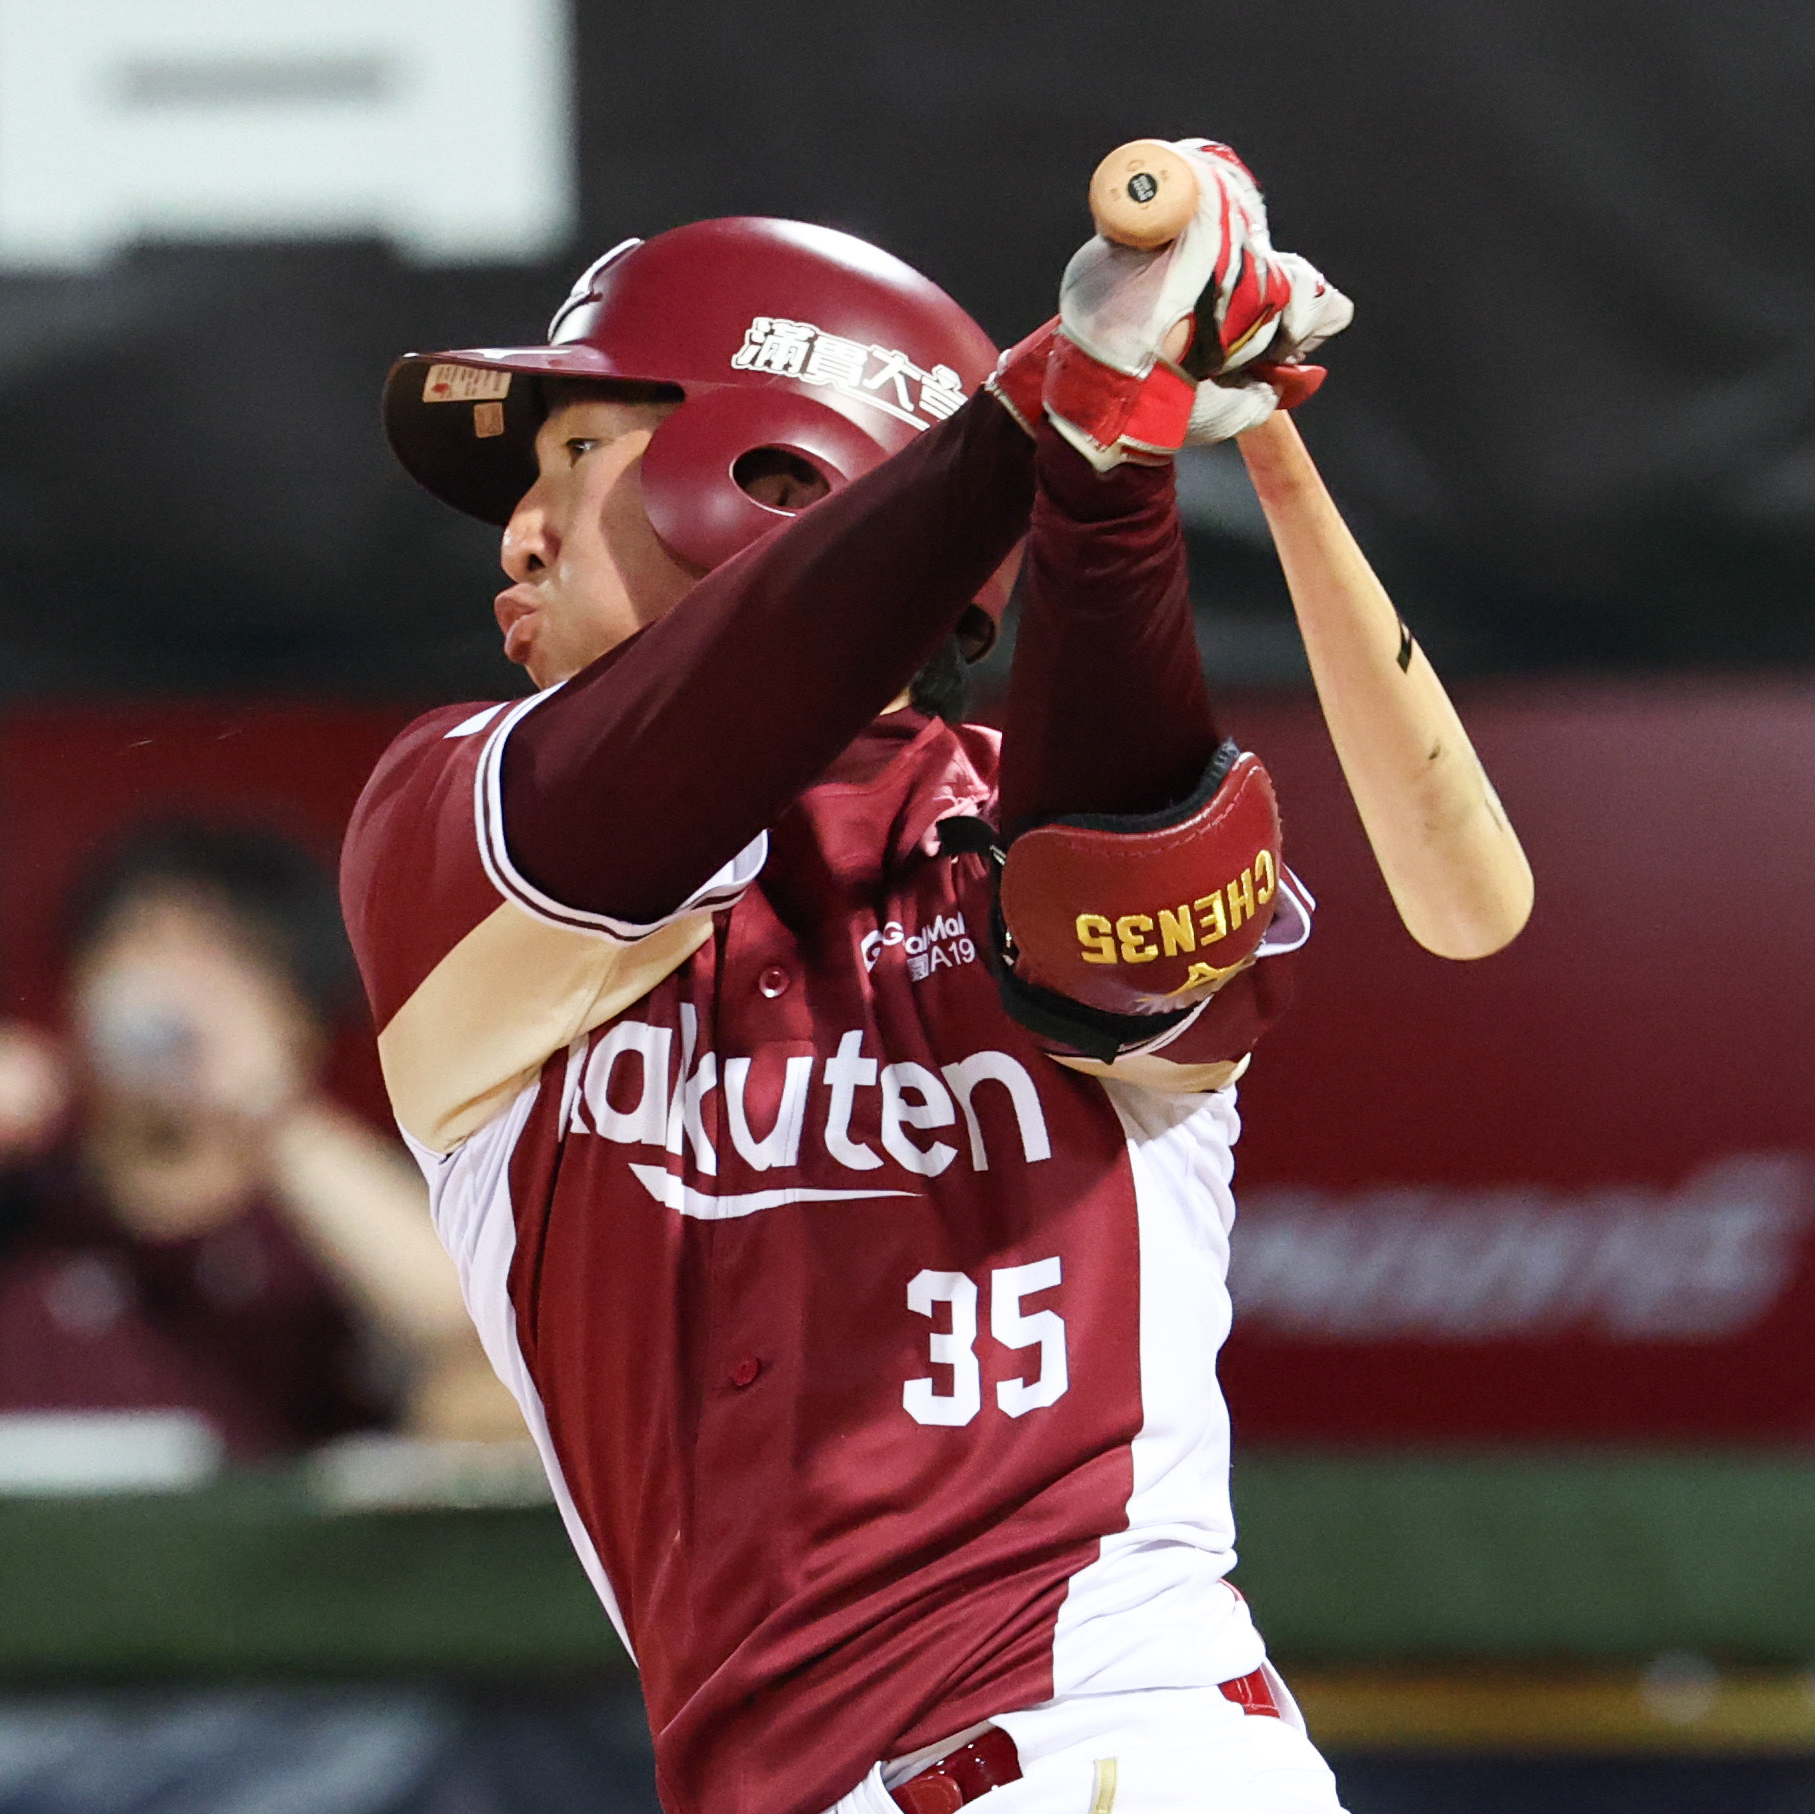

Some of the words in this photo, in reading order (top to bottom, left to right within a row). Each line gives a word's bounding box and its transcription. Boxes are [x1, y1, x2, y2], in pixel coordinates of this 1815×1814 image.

[930, 937, 976, 973] A19
[1075, 849, 1275, 965] CHEN35
[902, 1255, 1069, 1427] 35
